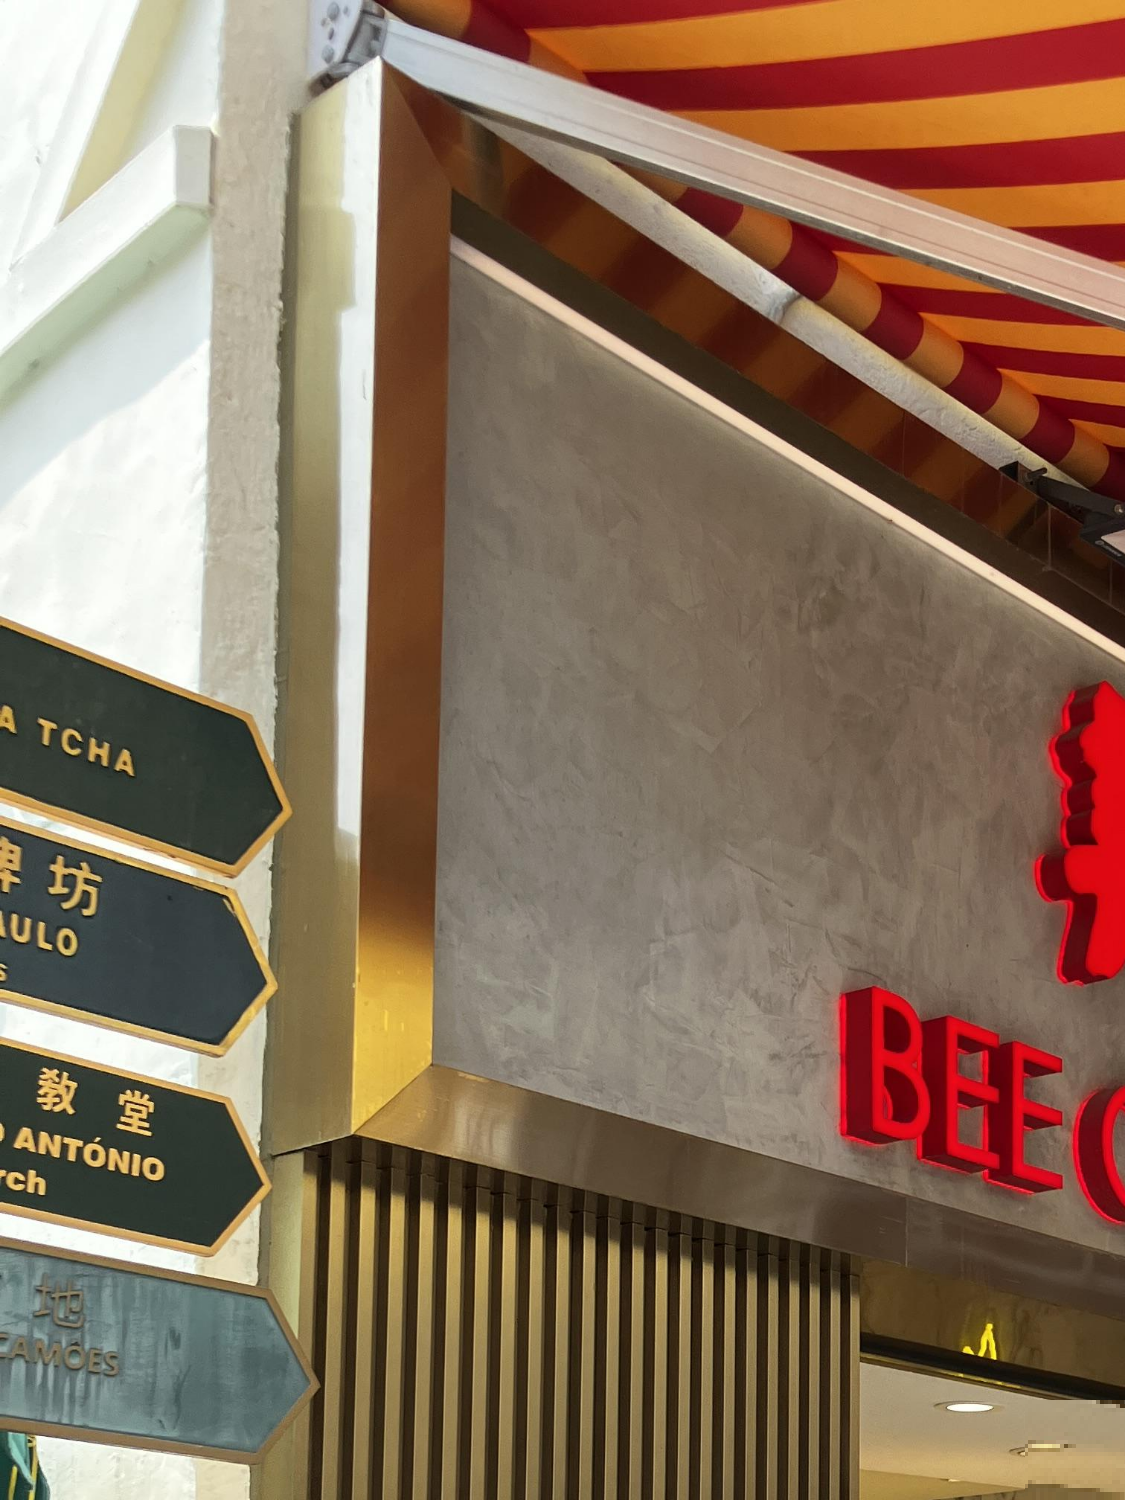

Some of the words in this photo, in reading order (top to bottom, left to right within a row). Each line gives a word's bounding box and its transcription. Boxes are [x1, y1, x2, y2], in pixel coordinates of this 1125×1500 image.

[37, 717, 135, 777] TCHA
[0, 909, 79, 957] ULO
[840, 985, 1063, 1194] BEE
[13, 1126, 166, 1182] ANTÓNIO
[33, 1272, 84, 1329] 地
